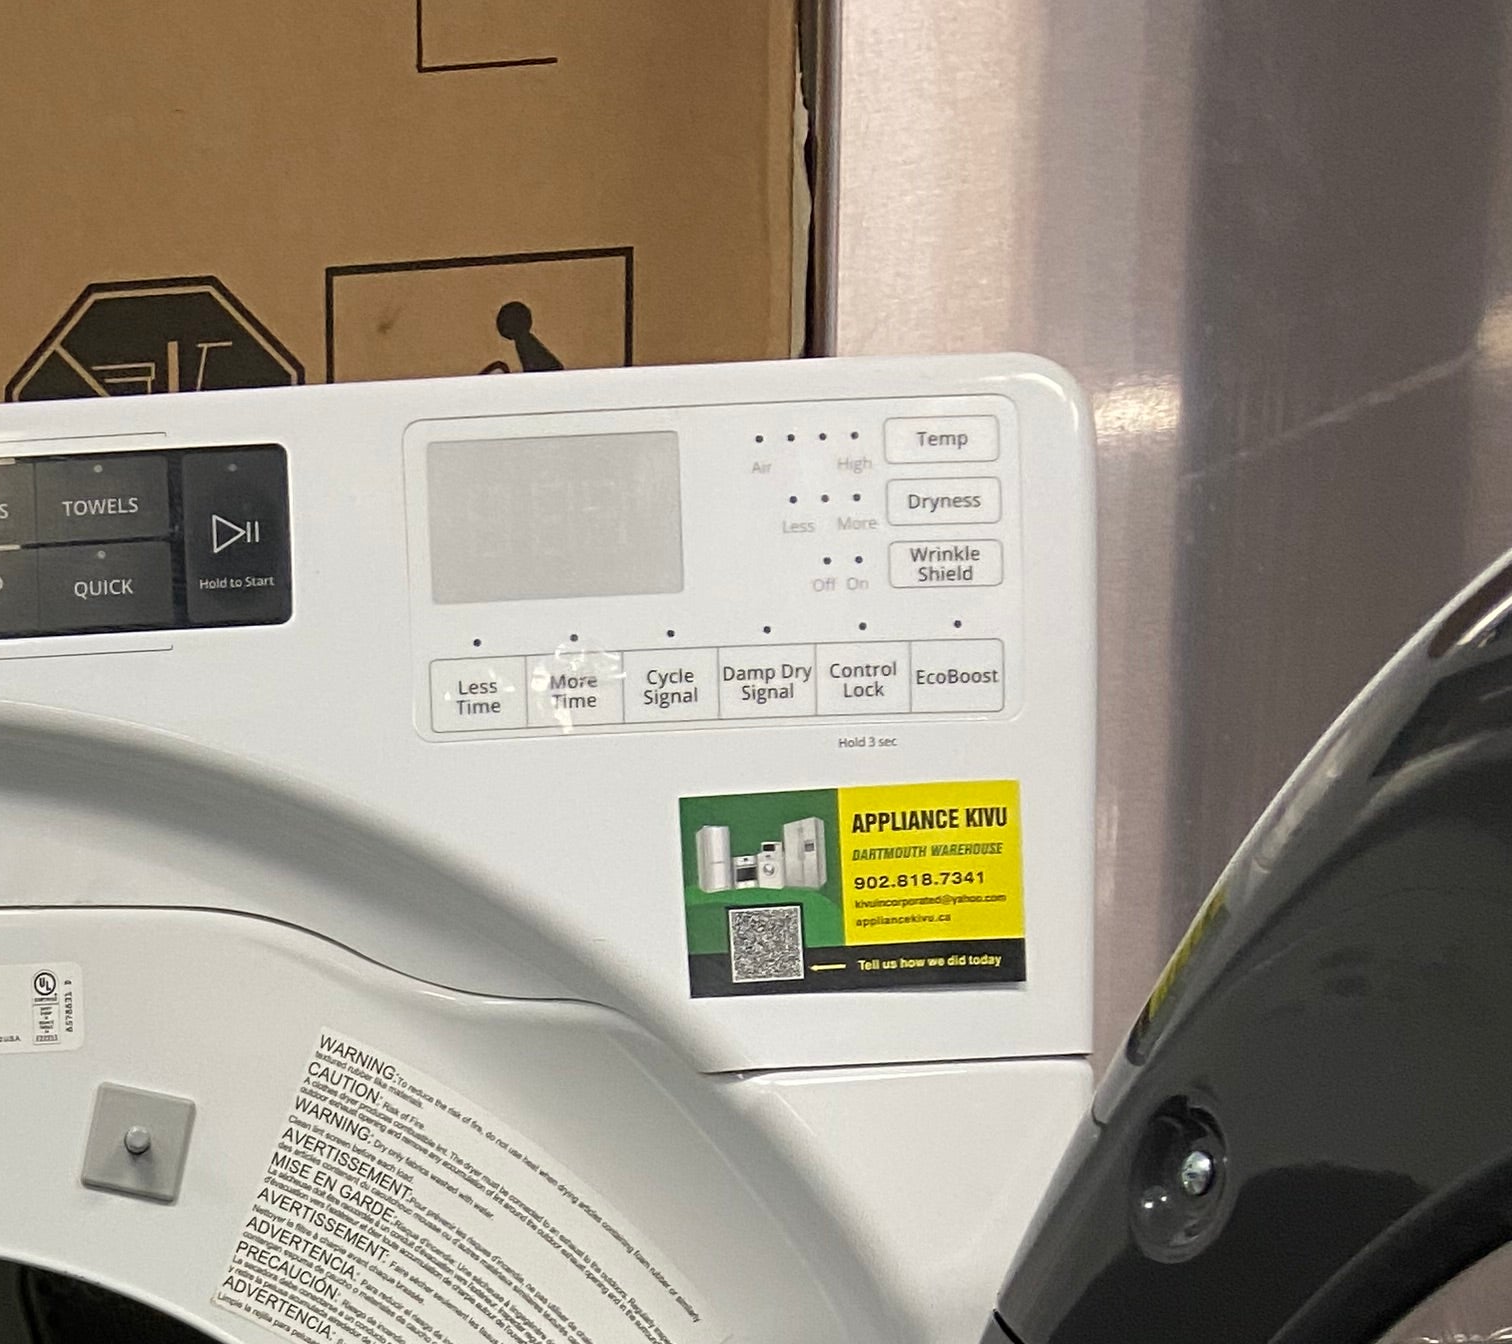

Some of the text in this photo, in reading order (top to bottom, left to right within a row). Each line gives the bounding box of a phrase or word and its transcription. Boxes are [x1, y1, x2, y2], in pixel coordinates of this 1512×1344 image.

[917, 431, 968, 449] Temp
[752, 456, 872, 474] Air High
[63, 498, 138, 516] TOWELS
[908, 492, 981, 511] Dryness
[783, 517, 877, 533] Less More
[910, 546, 980, 564] Wrinkle
[200, 575, 274, 590] Hold to Start
[919, 566, 973, 582] Shield
[74, 579, 133, 598] QUICK
[813, 578, 869, 592] Off On
[646, 668, 694, 687] Cycle
[723, 664, 812, 686] Damp Dry
[830, 661, 897, 680] Control
[916, 668, 999, 685] EcoBoost
[459, 680, 498, 696] Less
[550, 674, 597, 690] More
[844, 682, 885, 699] Lock
[553, 693, 596, 709] Time
[644, 688, 698, 708] Signal
[742, 683, 795, 703] Signal
[457, 698, 501, 714] Time
[838, 737, 898, 748] Hold 3 sec
[852, 807, 1007, 833] APPLIANCE KIVU
[853, 843, 1002, 860] DARTMOUTH WAREHOUSE
[854, 872, 984, 889] 902.818.7341
[856, 912, 951, 927] appliancekivu.ca
[858, 954, 1001, 971] Tell us how we did today
[39, 977, 51, 991] UL
[320, 1034, 400, 1083] WARNING:
[308, 1062, 383, 1106] CAUTION:
[295, 1096, 374, 1143] WARNING:
[271, 1152, 312, 1179] MISE
[314, 1171, 337, 1191] EN
[282, 1127, 413, 1202] AVERTISSEMENT:
[257, 1188, 389, 1263] AVERTISSEMENT:
[246, 1216, 360, 1281] ADVERTENCIA:
[223, 1275, 336, 1340] ADVERTENCIA:
